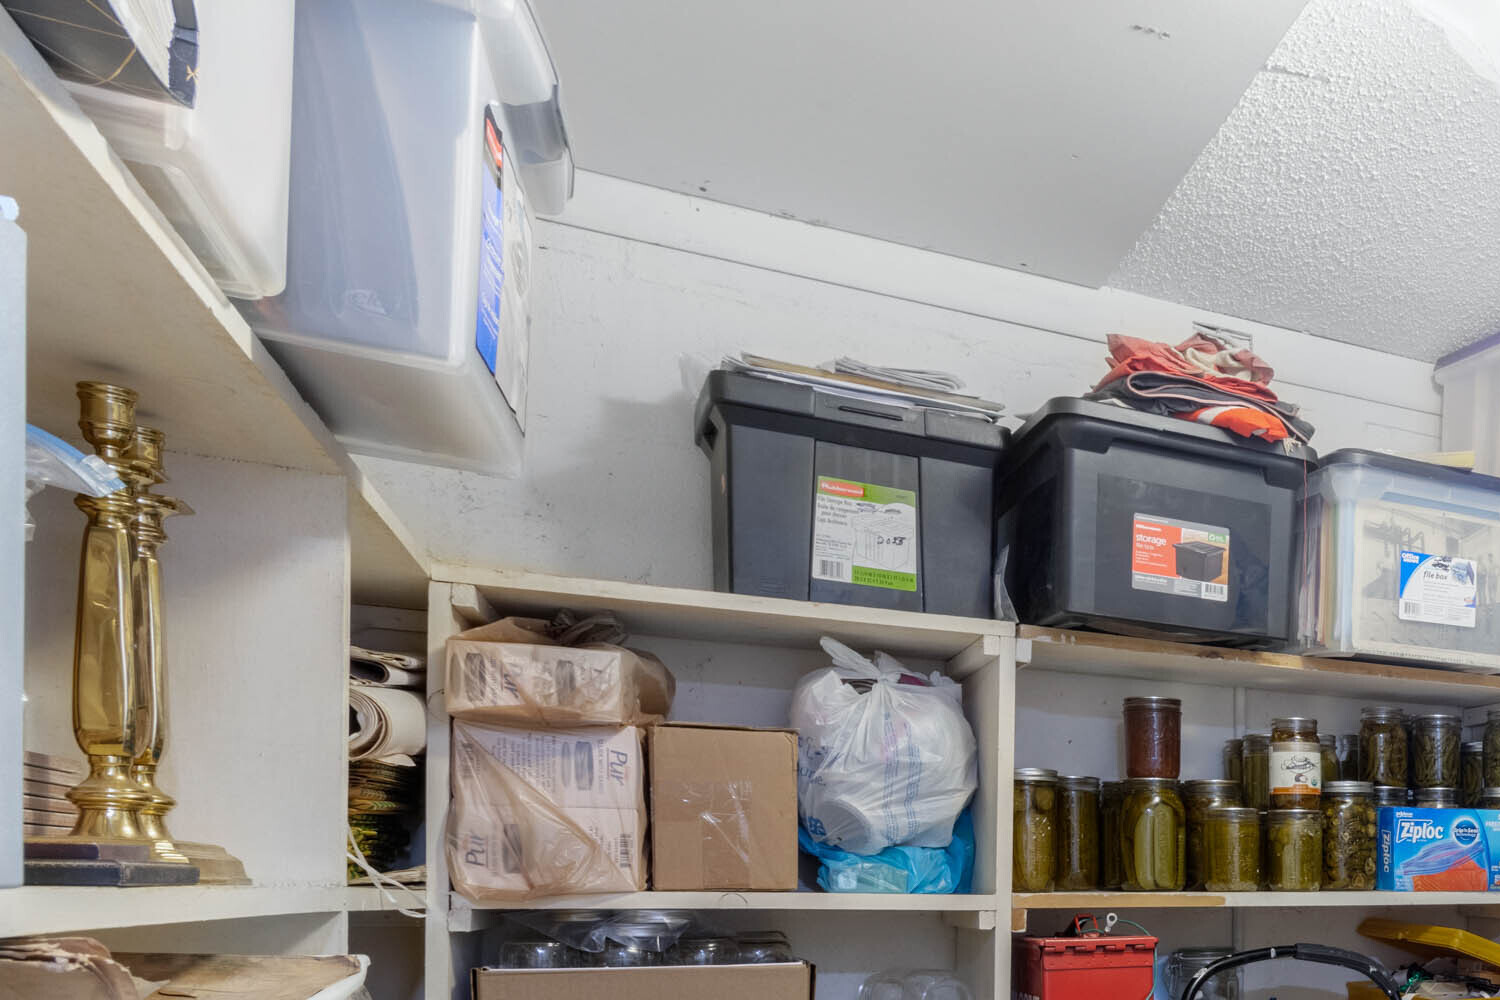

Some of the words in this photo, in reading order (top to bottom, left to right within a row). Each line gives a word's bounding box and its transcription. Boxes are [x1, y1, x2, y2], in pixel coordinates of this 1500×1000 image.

[1423, 570, 1434, 579] file
[610, 749, 628, 787] Pur
[1398, 820, 1445, 843] Ziploc
[465, 835, 486, 868] Pur
[1382, 831, 1392, 873] Ziploc
